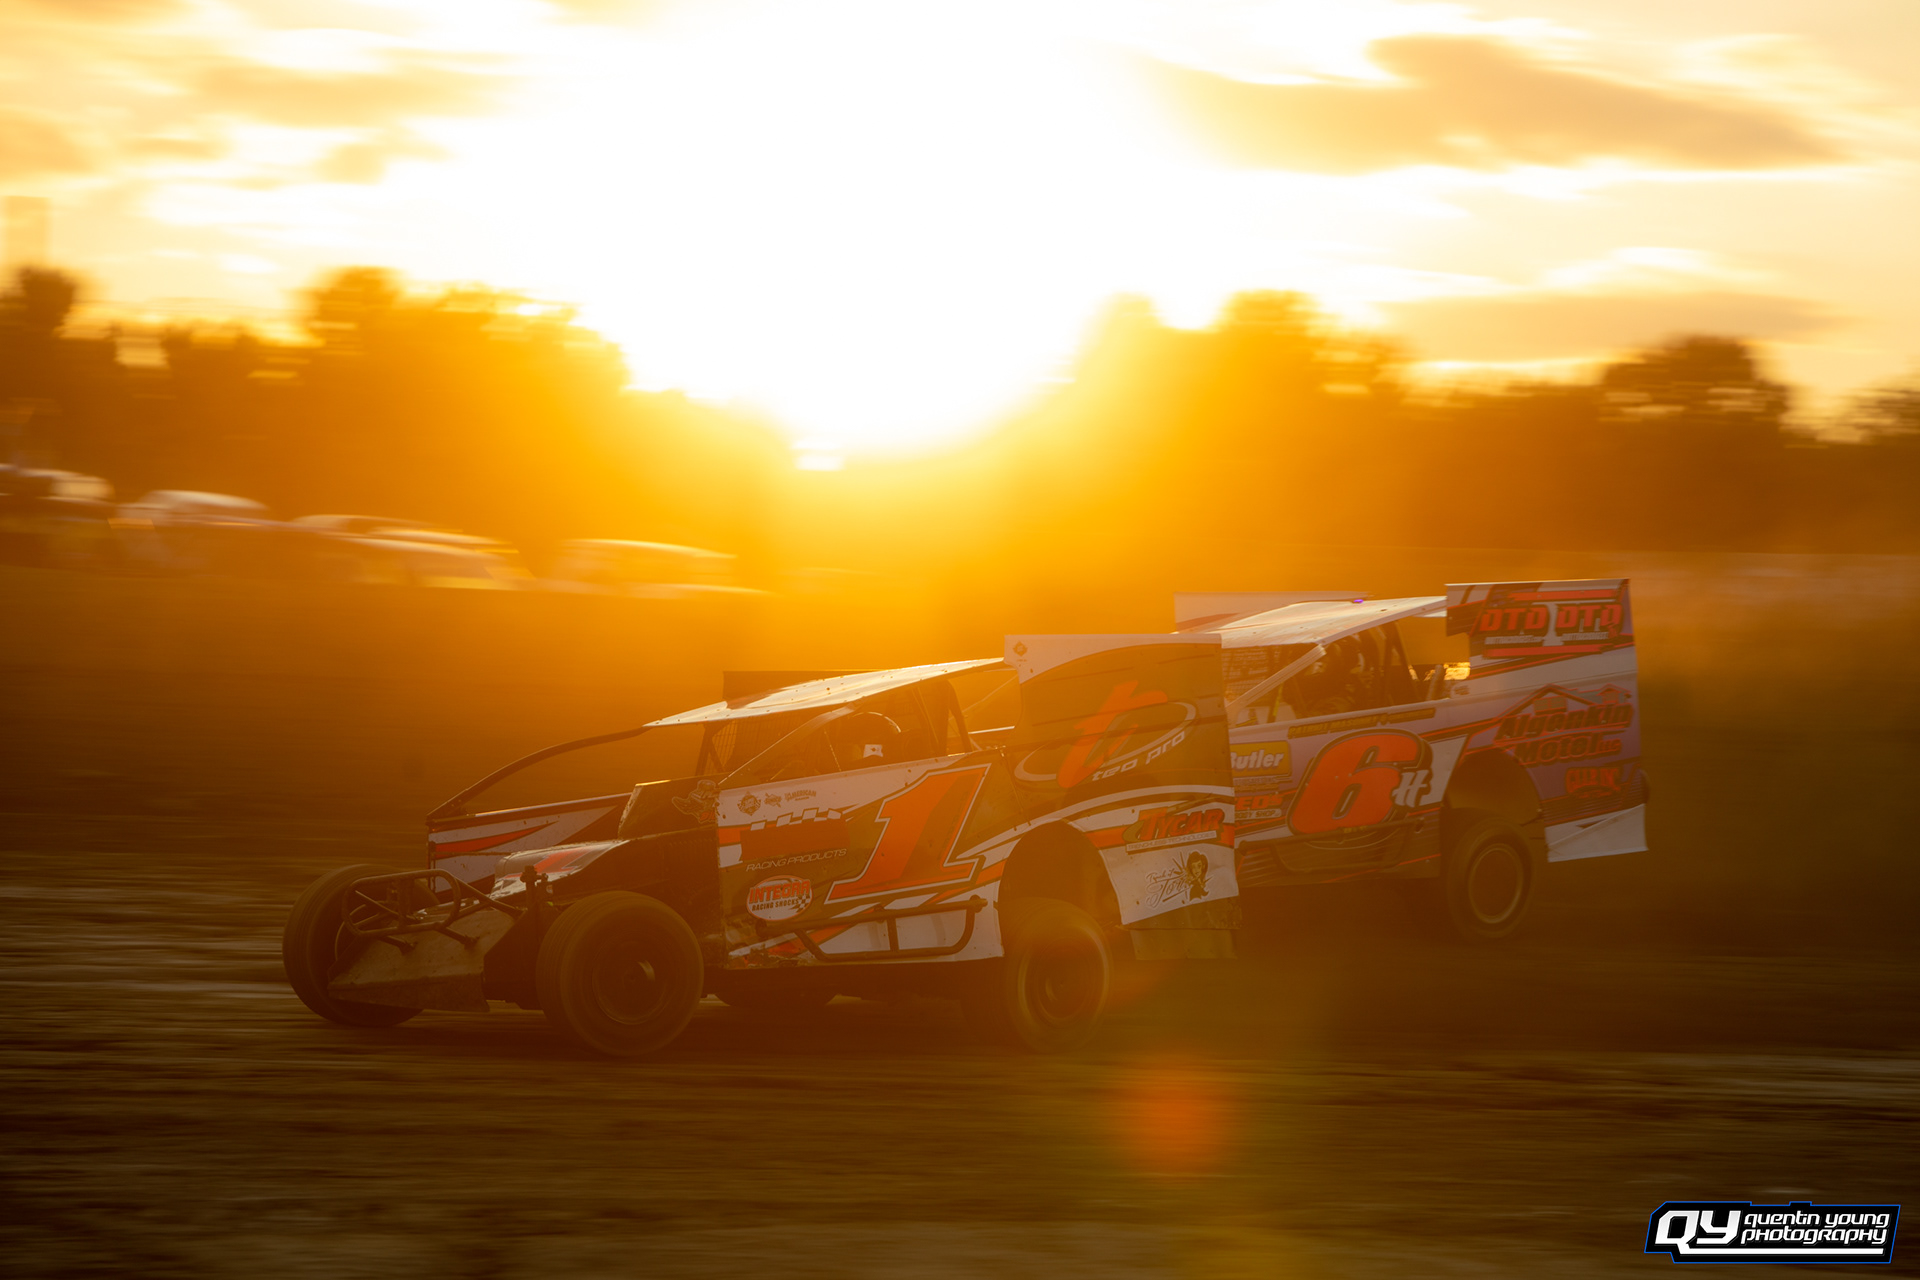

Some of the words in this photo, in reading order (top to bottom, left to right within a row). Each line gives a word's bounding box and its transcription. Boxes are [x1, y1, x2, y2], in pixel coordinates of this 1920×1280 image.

[824, 762, 992, 905] 1
[745, 858, 787, 873] RACING
[787, 848, 848, 866] PRODUCTS
[748, 879, 811, 904] INTEGRA
[752, 901, 774, 912] RACING
[775, 898, 800, 909] SHOCKS
